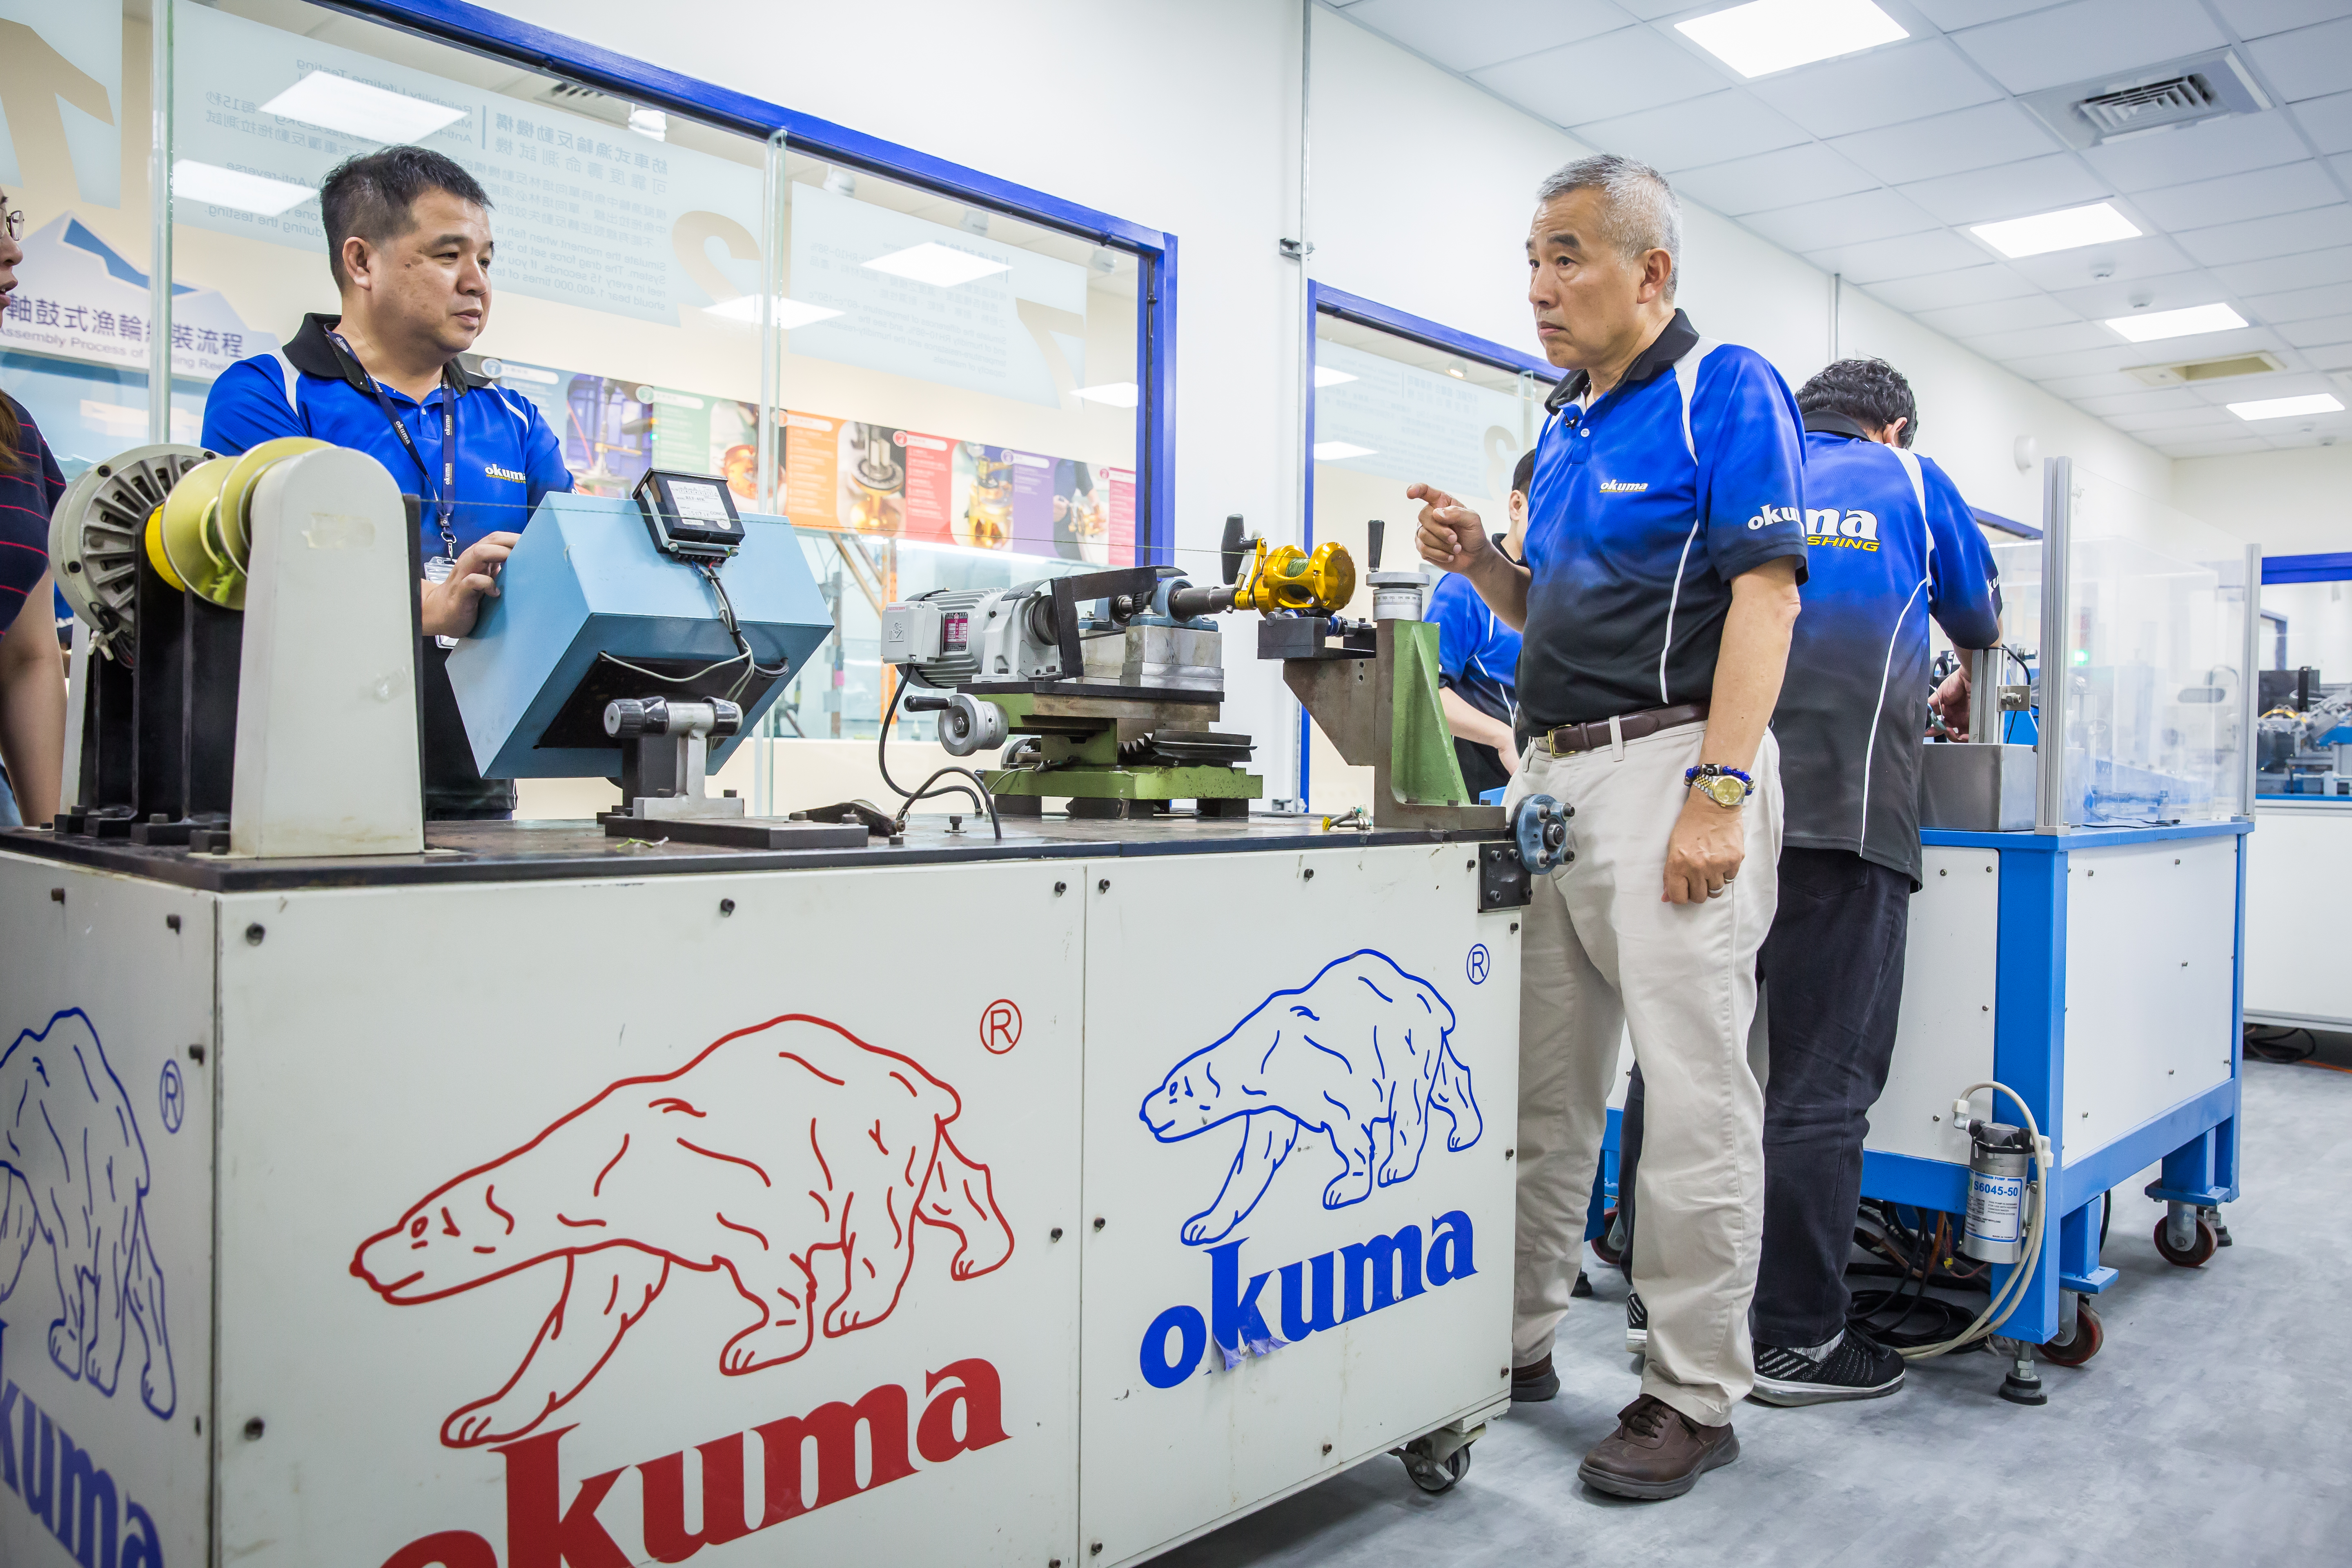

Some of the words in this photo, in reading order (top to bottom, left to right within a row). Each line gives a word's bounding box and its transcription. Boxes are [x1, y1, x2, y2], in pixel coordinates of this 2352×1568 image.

[5, 292, 244, 359] 軸鼓式漁輪裝流程
[70, 337, 127, 357] Process
[336, 337, 348, 352] okuma
[396, 421, 410, 445] okuma
[1600, 479, 1648, 491] okuma
[1807, 536, 1880, 552] SHING
[1974, 1180, 2018, 1196] S6045-50
[1140, 1210, 1478, 1389] okuma
